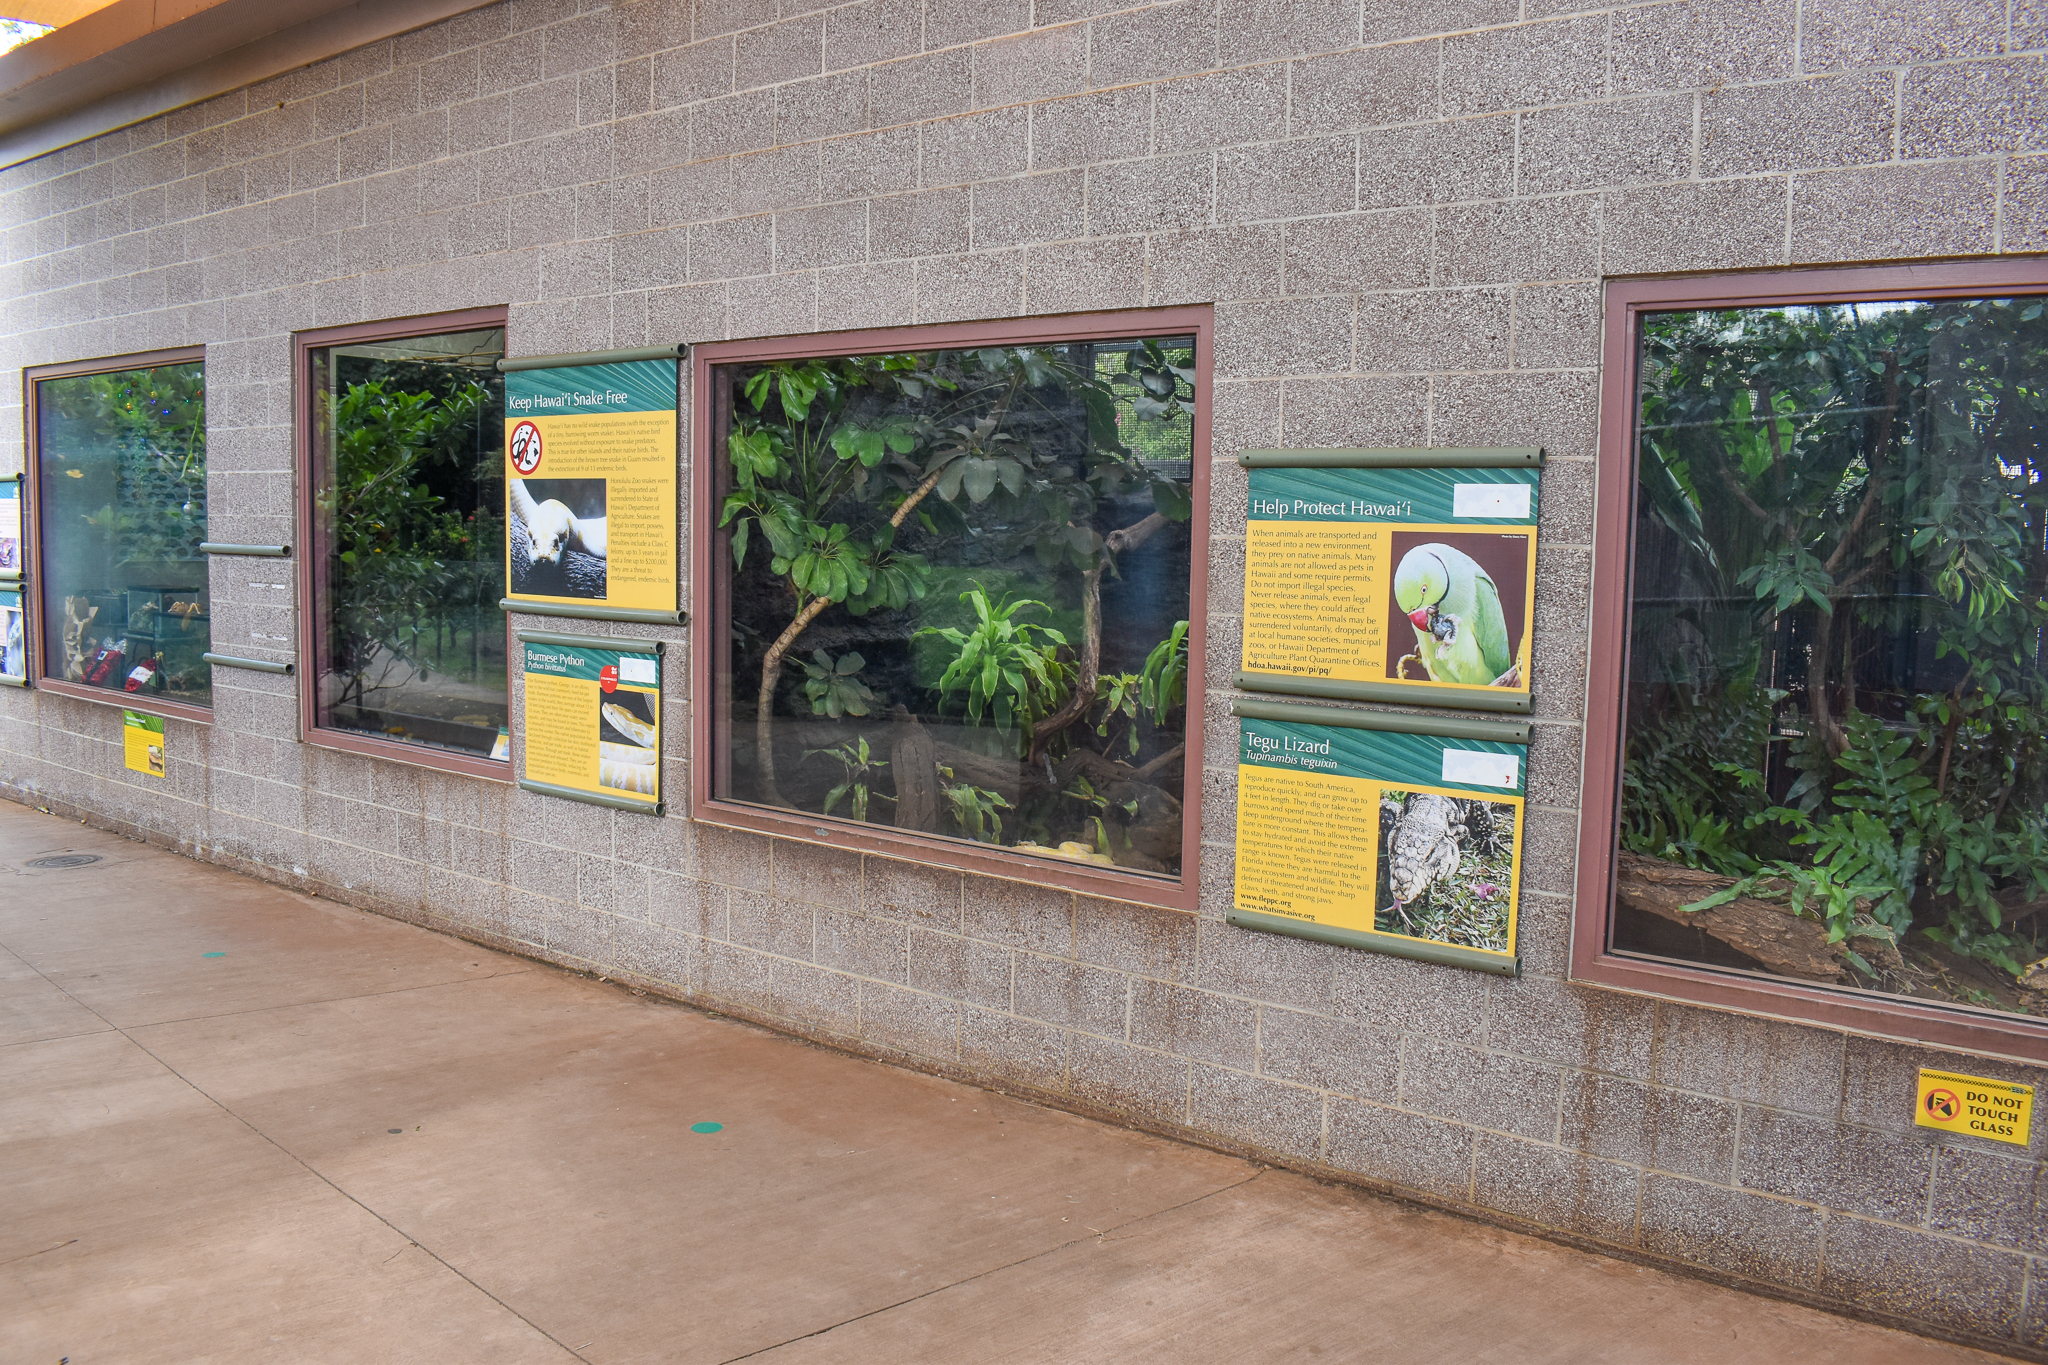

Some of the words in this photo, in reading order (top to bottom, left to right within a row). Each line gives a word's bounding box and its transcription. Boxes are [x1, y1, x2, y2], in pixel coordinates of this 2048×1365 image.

[510, 396, 532, 412] Keep
[535, 393, 570, 408] Hawai'i
[574, 390, 603, 406] Snake
[606, 390, 628, 404] Free
[1254, 499, 1289, 518] Help
[1294, 500, 1346, 515] Protect
[1351, 500, 1411, 516] Hawai'i
[1318, 531, 1360, 541] transported
[1251, 539, 1281, 547] released
[1322, 541, 1372, 550] environment,
[1251, 549, 1267, 559] they
[1268, 551, 1284, 560] prey
[1321, 551, 1352, 559] animals.
[1354, 552, 1376, 563] Many
[1251, 559, 1278, 567] animals
[1307, 561, 1337, 569] allowed
[1348, 563, 1364, 573] pets
[1314, 572, 1341, 582] require
[1342, 573, 1372, 584] permits.
[1277, 581, 1300, 591] import
[1302, 582, 1324, 592] illegal
[1326, 583, 1355, 593] species.
[1249, 600, 1277, 610] species,
[1279, 601, 1301, 609] where
[1303, 602, 1319, 613] they
[1320, 603, 1342, 611] could
[1343, 604, 1364, 612] affect
[1300, 592, 1330, 601] animals,
[1352, 594, 1370, 605] legal
[1272, 611, 1314, 623] ecosystems.
[1316, 613, 1346, 622] Animals
[1348, 617, 1364, 625] may
[1249, 620, 1291, 629] surrendered
[1292, 622, 1332, 634] voluntarily,
[1334, 625, 1366, 636] dropped
[1257, 630, 1274, 638] local
[1276, 632, 1306, 640] humane
[1307, 633, 1340, 644] societies,
[1342, 636, 1381, 648] municipal
[1278, 642, 1303, 650] Hawaii
[1305, 644, 1349, 656] Department
[528, 650, 558, 663] Burmese
[560, 654, 584, 668] Python
[1247, 650, 1287, 662] Agriculture
[1288, 653, 1307, 661] Plant
[1308, 654, 1350, 667] Quarantine
[1352, 657, 1381, 666] Offices.
[1248, 661, 1331, 675] hdoa.hawaii.gov/pi/pq/
[1246, 732, 1279, 753] Tegu
[1284, 736, 1330, 754] Lizard
[1246, 750, 1298, 765] Tupinambis
[1301, 756, 1338, 769] teguixin
[1244, 773, 1262, 784] Tegus
[1275, 776, 1295, 785] native
[1304, 780, 1324, 788] South
[1325, 782, 1355, 793] America,
[1244, 782, 1275, 794] reproduce
[1276, 786, 1302, 798] quickly,
[1303, 789, 1316, 797] and
[1331, 794, 1348, 804] grow
[1350, 796, 1359, 805] up
[1270, 794, 1291, 806] length.
[1292, 797, 1308, 808] They
[1309, 799, 1321, 810] dig
[1331, 802, 1345, 810] take
[1243, 800, 1269, 810] burrows
[1270, 803, 1283, 812] and
[1284, 805, 1304, 817] spend
[1305, 808, 1324, 817] much
[1334, 812, 1350, 820] their
[1351, 814, 1367, 823] time
[1242, 809, 1259, 820] deep
[1260, 811, 1301, 826] underground
[1302, 817, 1324, 826] where
[1325, 820, 1336, 828] the
[1337, 822, 1367, 835] tempera-
[1242, 818, 1255, 826] ture
[1281, 824, 1311, 834] constant.
[1312, 828, 1326, 836] This
[1327, 830, 1349, 840] allows
[1350, 833, 1368, 842] them
[1240, 893, 1291, 908] www.fleppc.org
[1241, 902, 1315, 921] www.whatsinvasive.org
[1966, 1091, 1988, 1103] DO
[1993, 1096, 2023, 1109] NOT
[1968, 1106, 2018, 1123] TOUCH
[1970, 1120, 2013, 1136] GLASS
